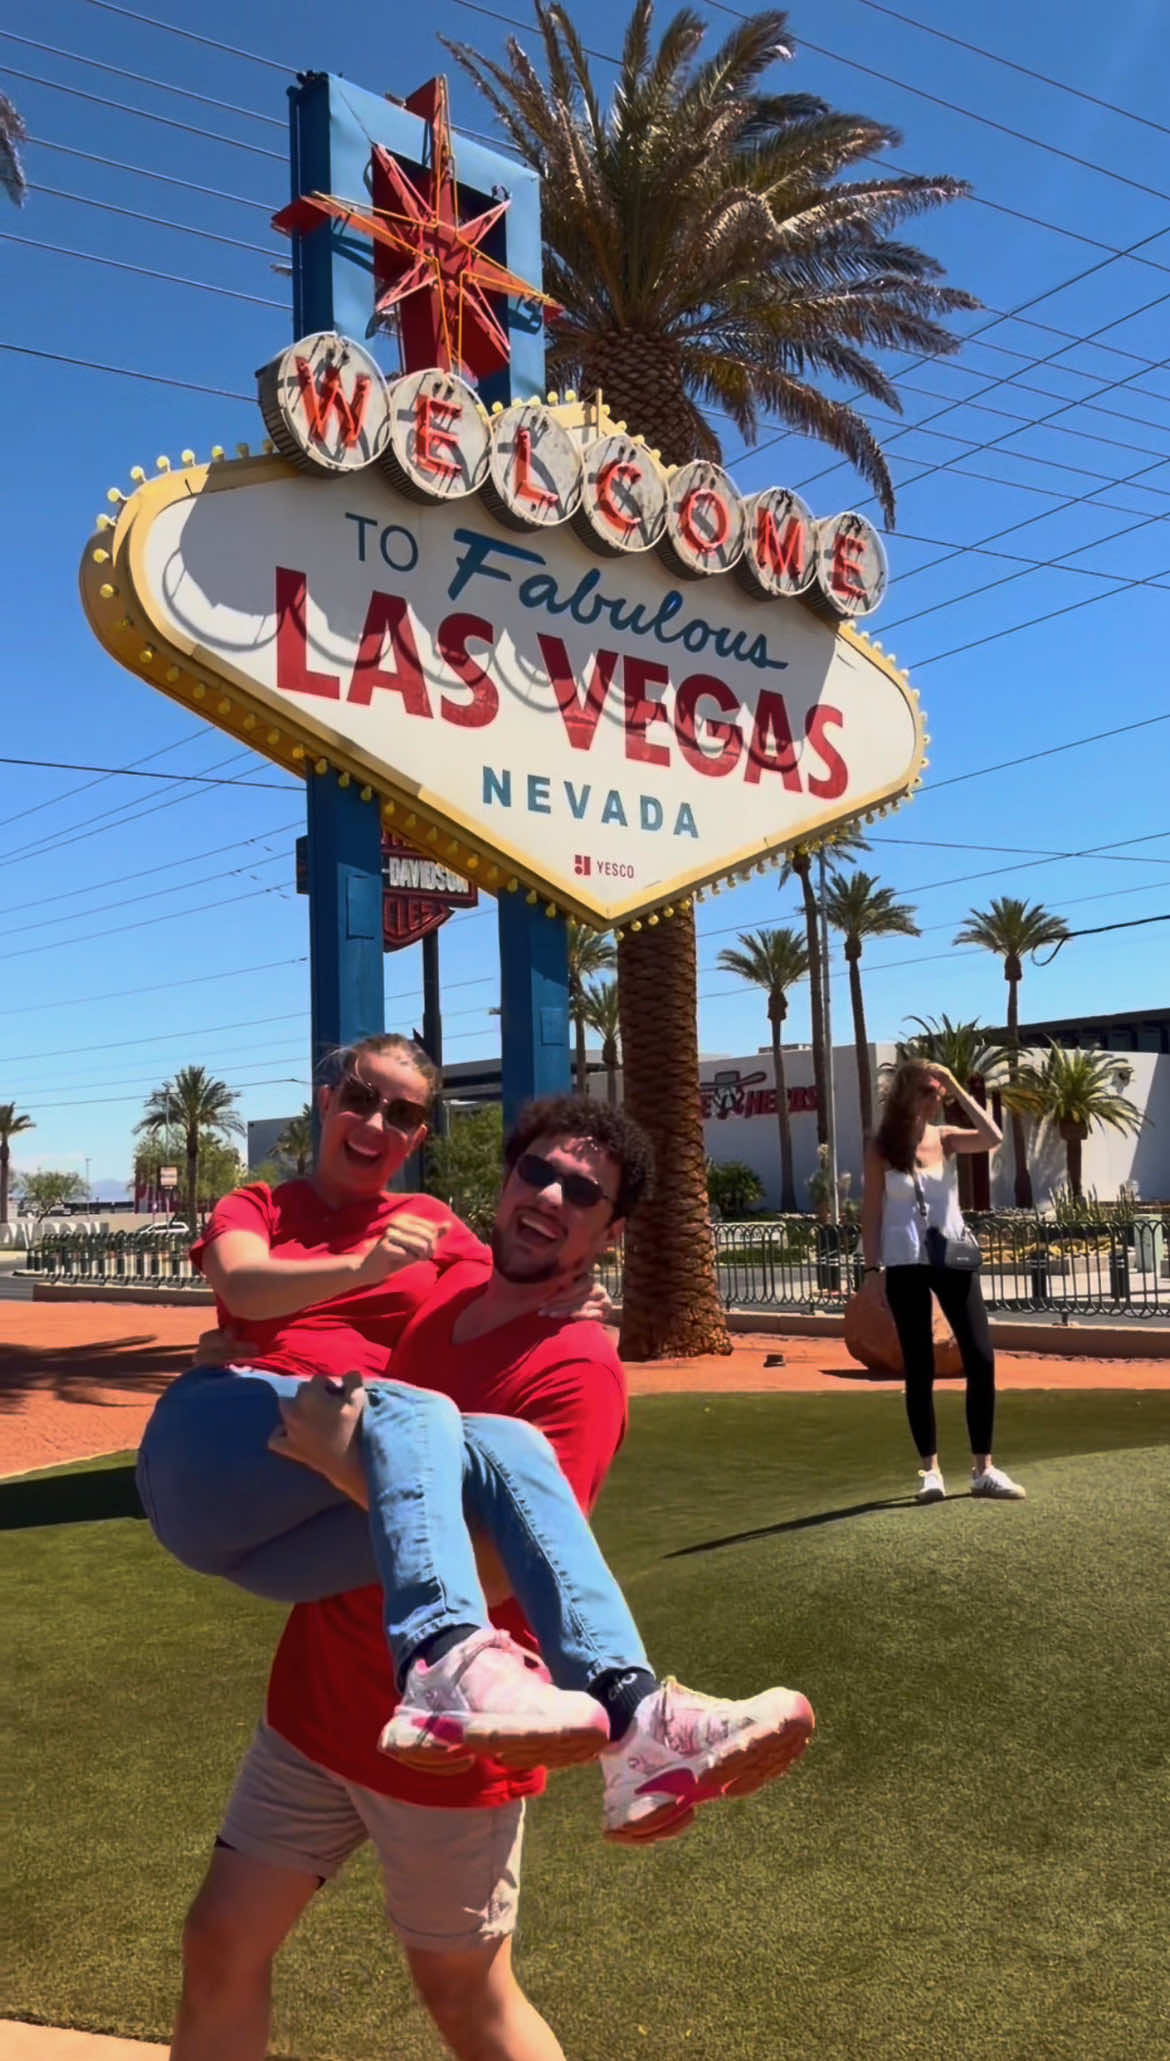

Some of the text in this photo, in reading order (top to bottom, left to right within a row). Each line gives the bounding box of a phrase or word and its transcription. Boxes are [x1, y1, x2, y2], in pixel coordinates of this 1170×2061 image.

[294, 355, 869, 600] WELCOME
[345, 512, 788, 669] TO Fabulous
[275, 565, 849, 799] LAS VEGAS
[483, 766, 699, 838] NEVADA
[597, 861, 634, 879] YESCO
